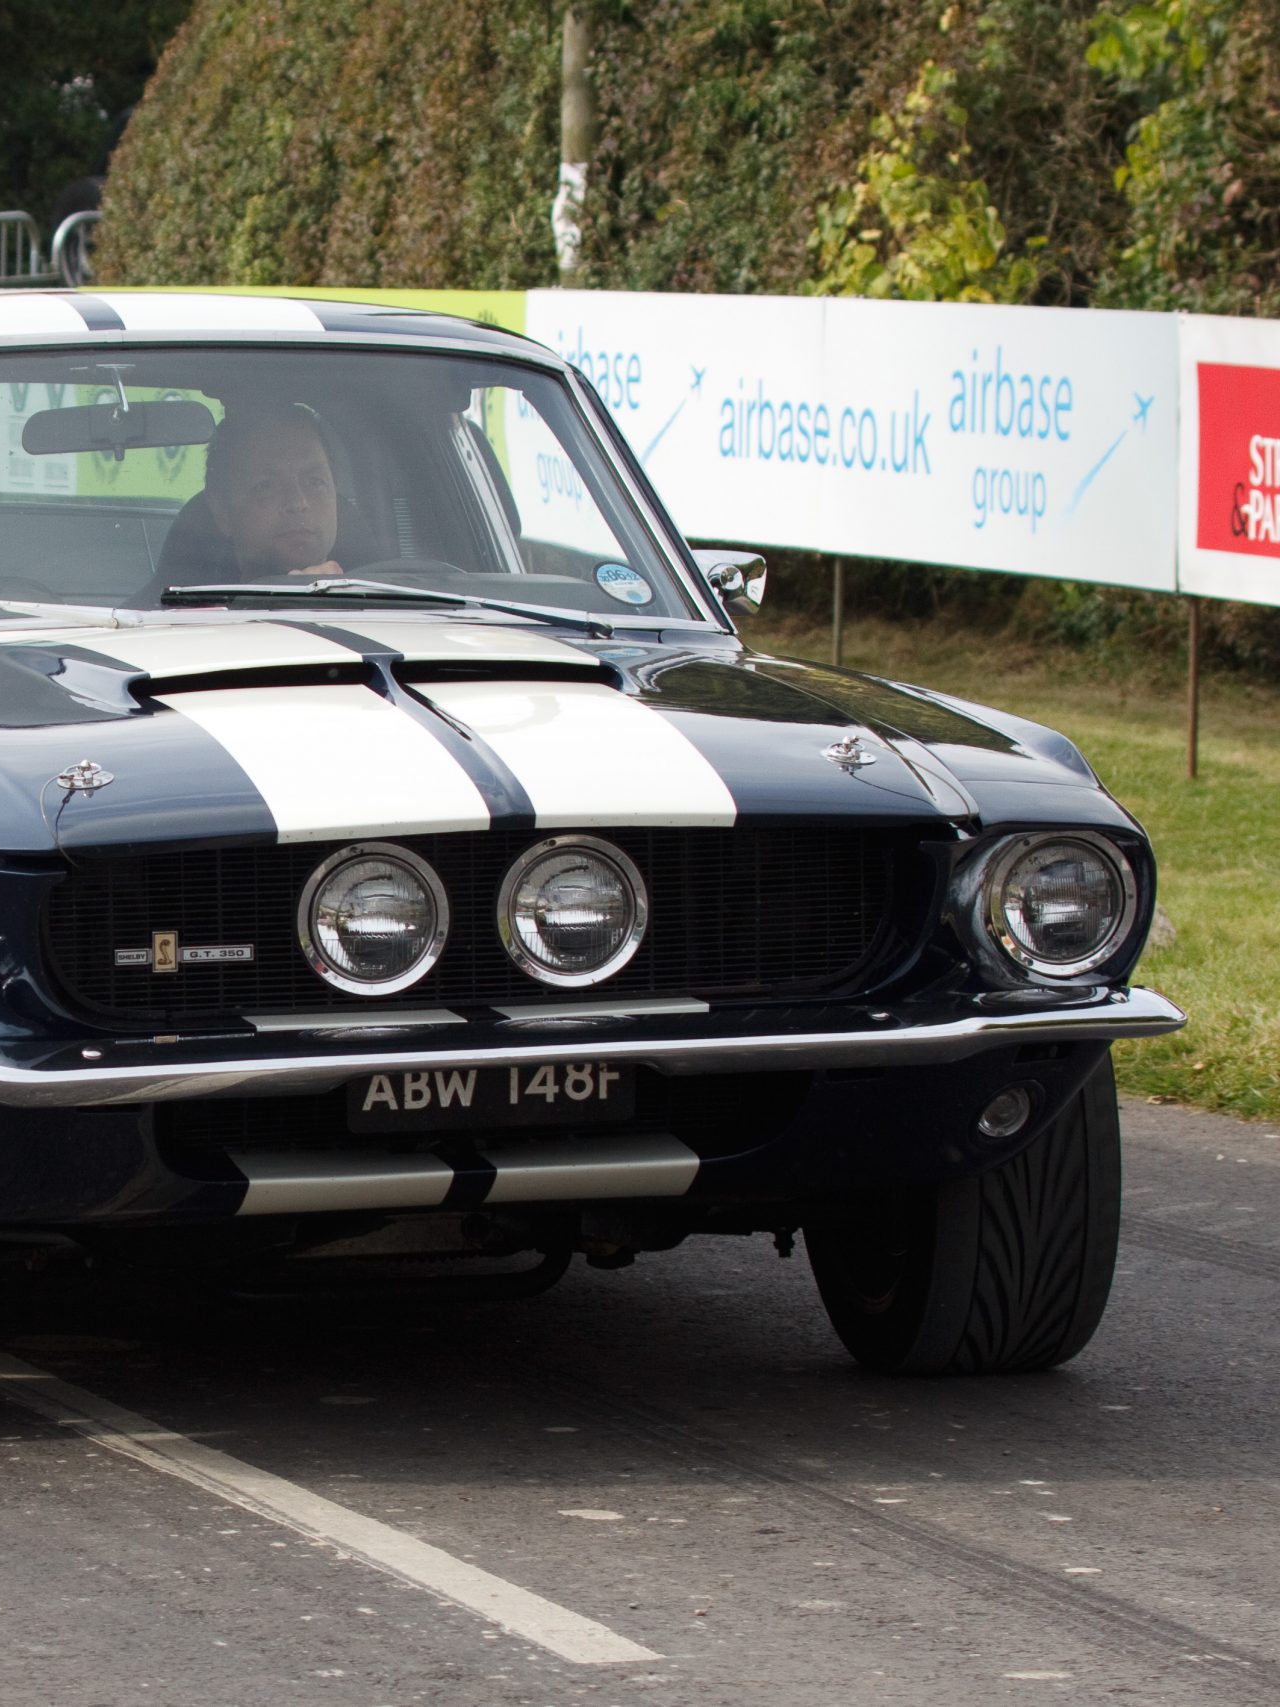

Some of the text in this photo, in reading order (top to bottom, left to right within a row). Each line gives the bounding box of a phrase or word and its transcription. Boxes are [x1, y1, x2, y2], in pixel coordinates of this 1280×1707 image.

[557, 326, 641, 410] base
[949, 345, 1073, 441] airbase
[719, 378, 932, 475] airbase.co.uk
[536, 452, 583, 513] group
[973, 466, 1047, 534] group
[118, 953, 145, 961] SHELBY
[219, 949, 245, 958] 350
[362, 1062, 620, 1111] ABW 148F
